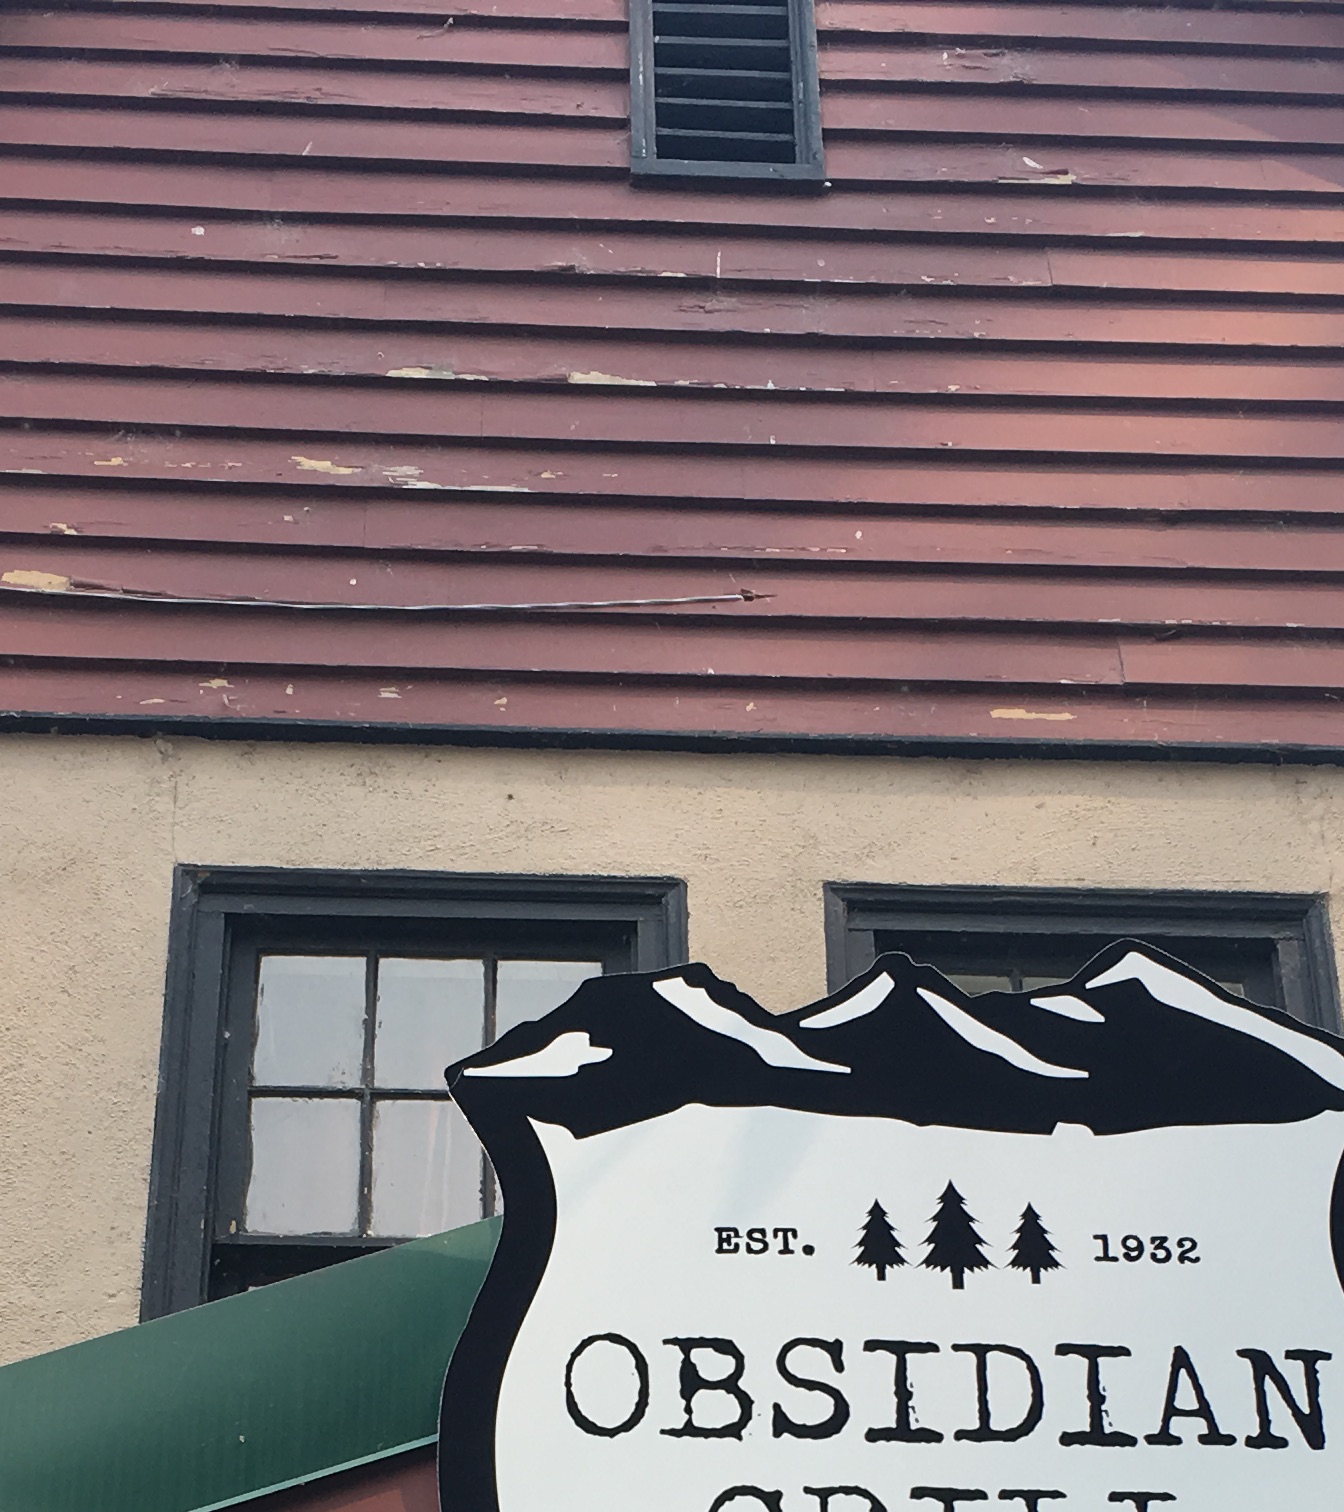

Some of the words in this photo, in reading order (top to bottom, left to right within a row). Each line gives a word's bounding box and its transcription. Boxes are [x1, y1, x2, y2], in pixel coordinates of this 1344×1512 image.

[713, 1226, 816, 1257] EST.
[1092, 1233, 1201, 1265] 1932
[564, 1332, 1333, 1451] OBSIDIAN
